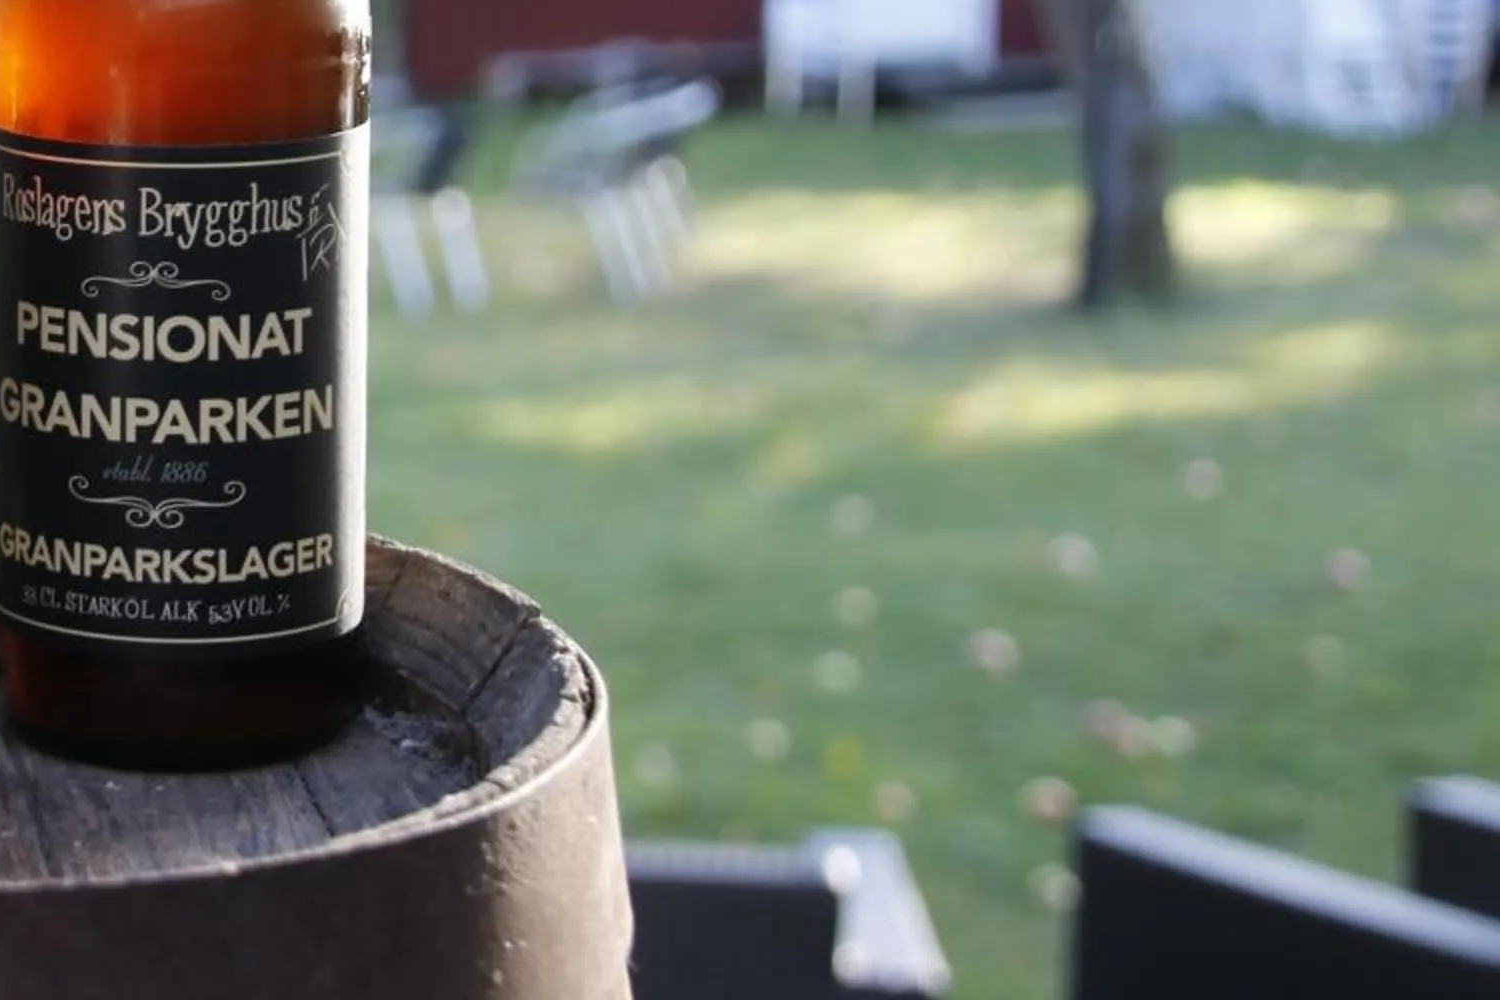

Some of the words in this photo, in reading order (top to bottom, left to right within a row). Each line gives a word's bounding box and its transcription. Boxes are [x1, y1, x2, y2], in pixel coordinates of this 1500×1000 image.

[3, 172, 127, 242] Roslagens
[138, 182, 303, 250] Brygghus
[16, 300, 313, 364] PENSIONAT
[0, 376, 335, 445] GRANPARKEN
[0, 522, 333, 585] GRANPARKSLAGER
[160, 599, 202, 622] ALK
